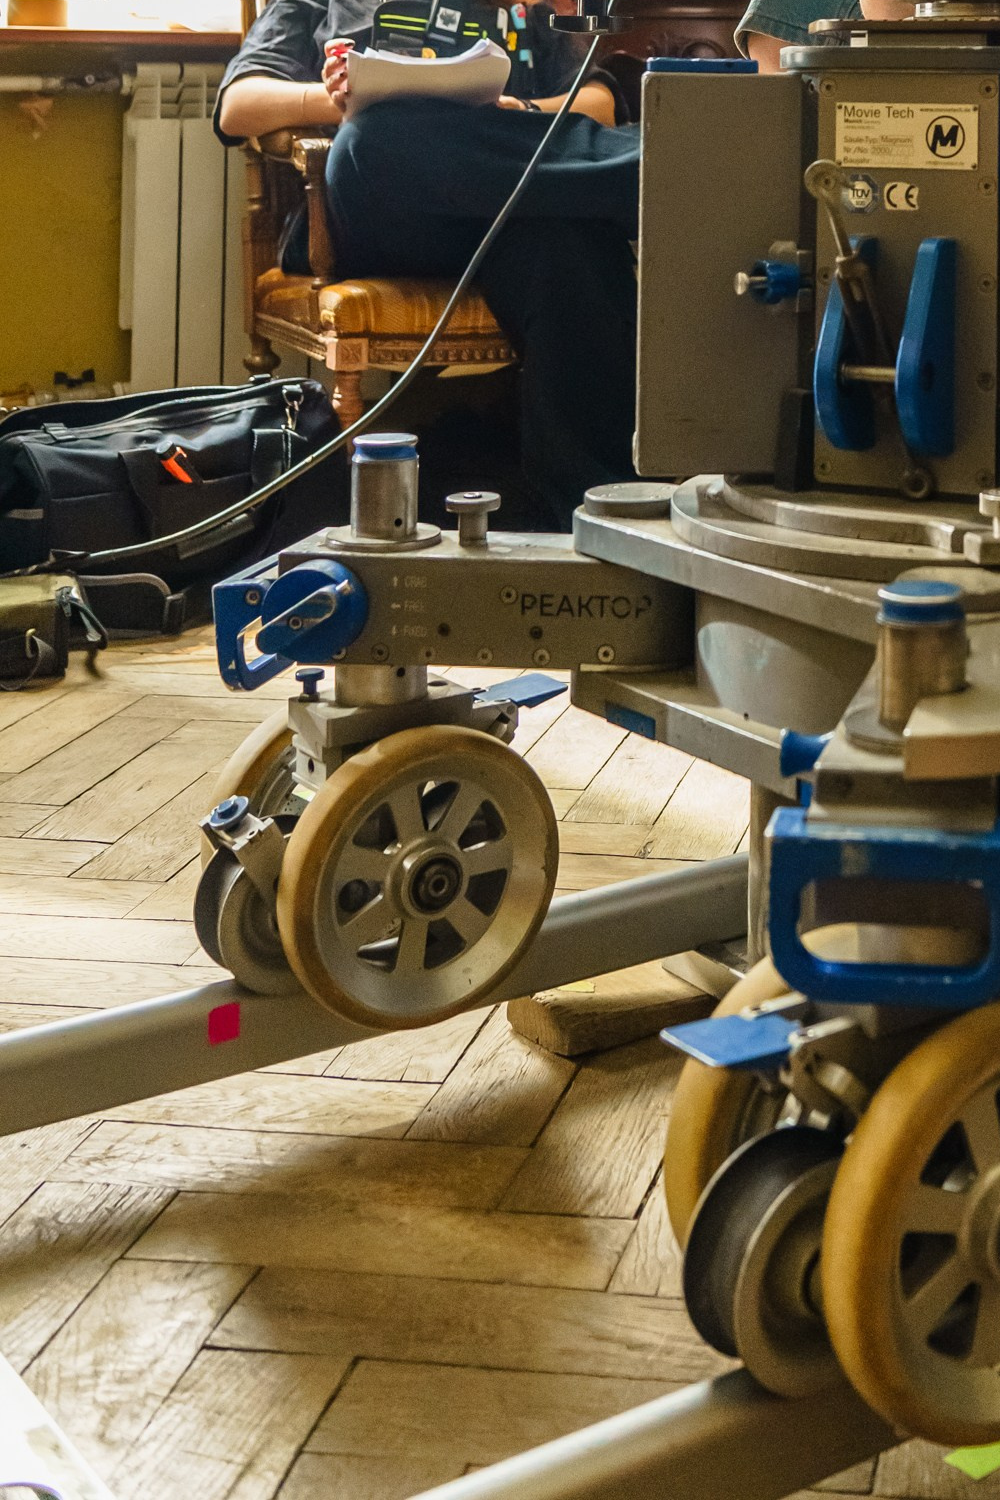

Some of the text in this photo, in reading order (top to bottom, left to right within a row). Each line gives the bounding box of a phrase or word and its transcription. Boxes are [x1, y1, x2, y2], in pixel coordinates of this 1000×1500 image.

[843, 105, 915, 119] Movie Tech
[886, 183, 916, 208] CE
